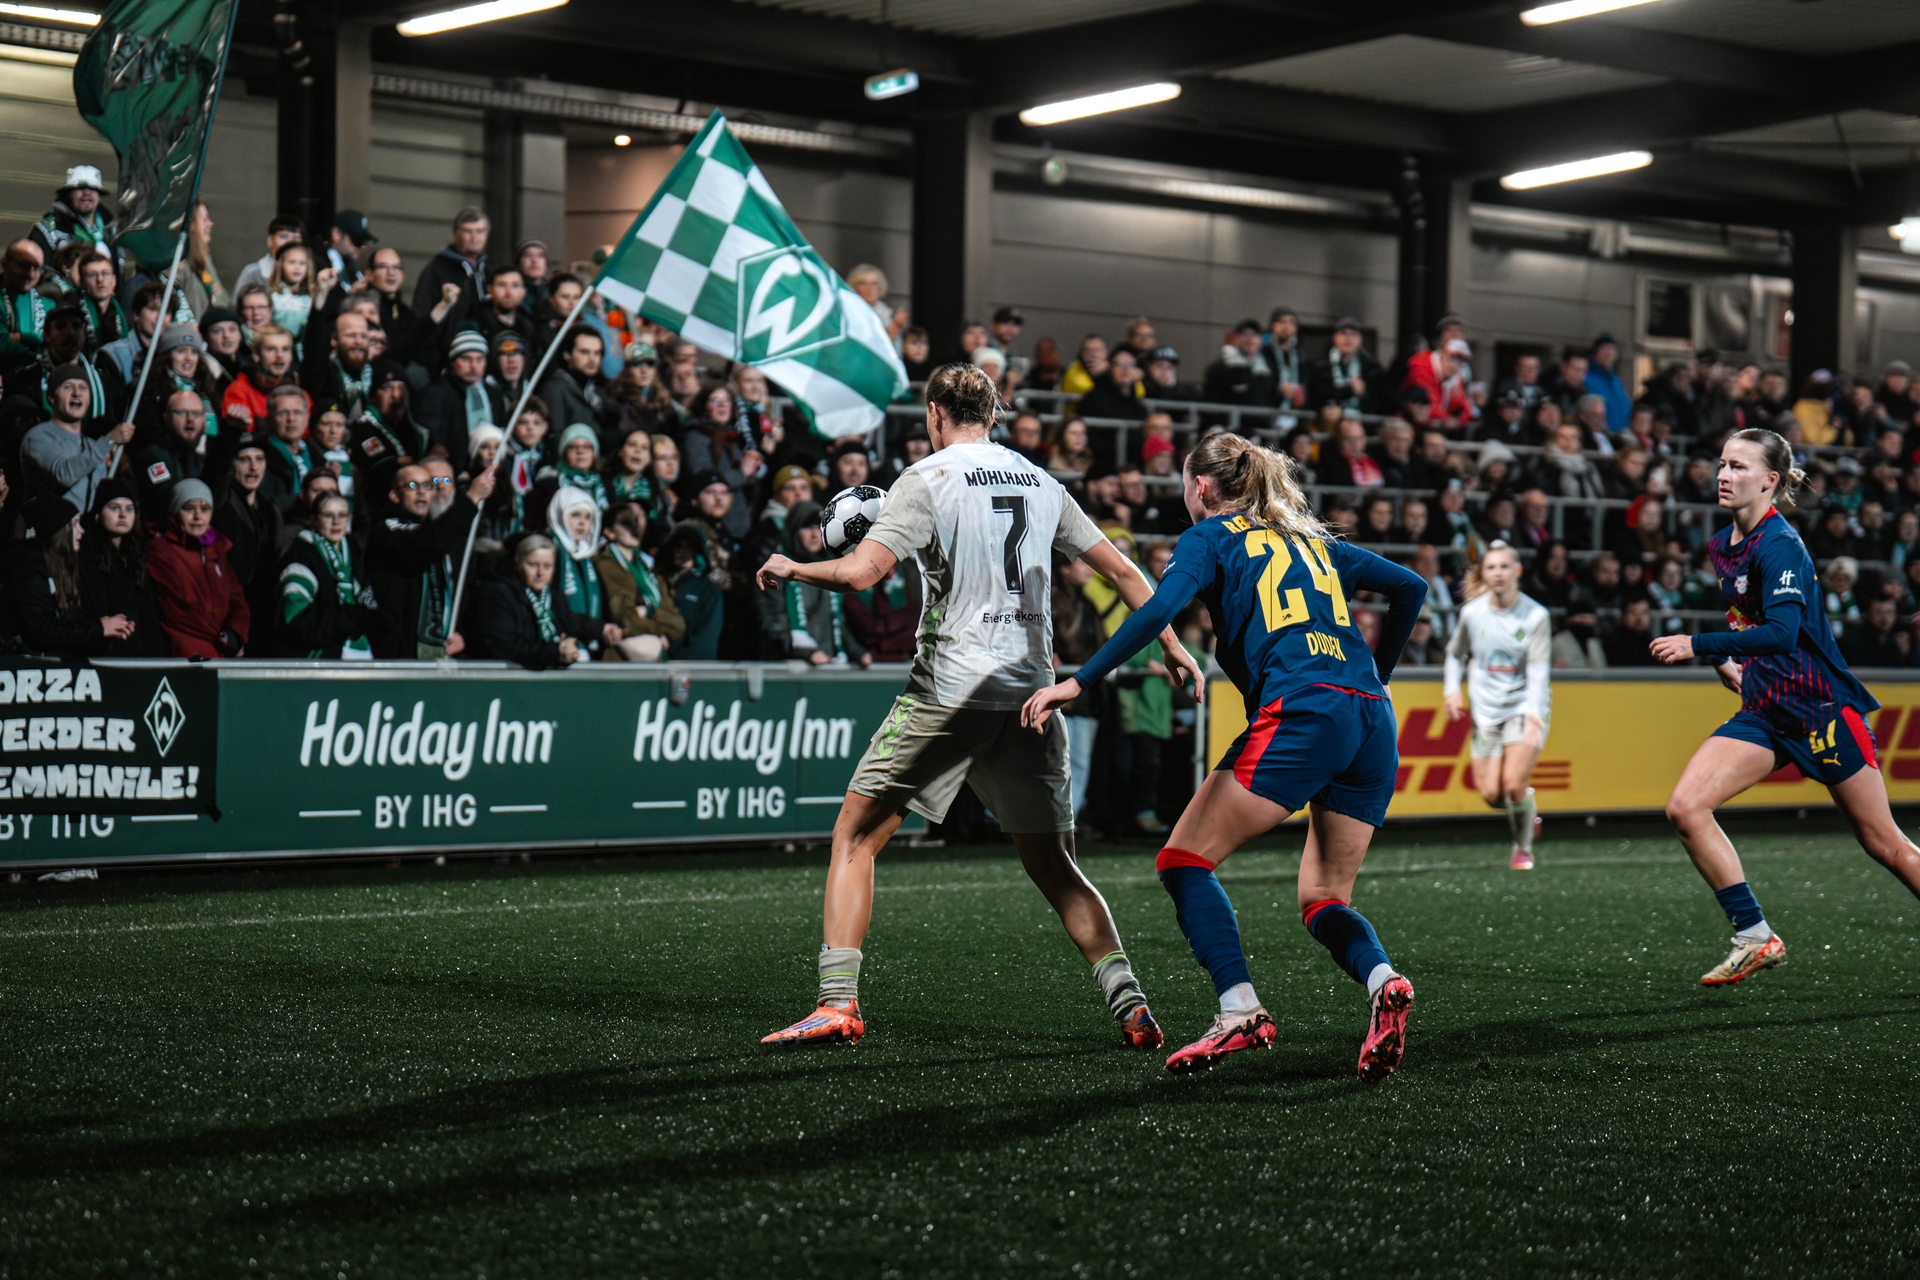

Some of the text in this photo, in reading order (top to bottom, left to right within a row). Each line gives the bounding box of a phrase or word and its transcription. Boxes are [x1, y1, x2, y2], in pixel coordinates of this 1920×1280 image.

[964, 467, 1041, 488] MÜHLHAUS
[991, 496, 1030, 595] 7
[1244, 529, 1351, 634] 24
[1305, 630, 1347, 662] DUDEK
[0, 716, 137, 752] ERDER
[300, 697, 552, 781] Holiday Inn
[633, 697, 853, 775] Holiday Inn
[374, 792, 478, 829] BY IHG
[696, 785, 786, 820] BY IHG
